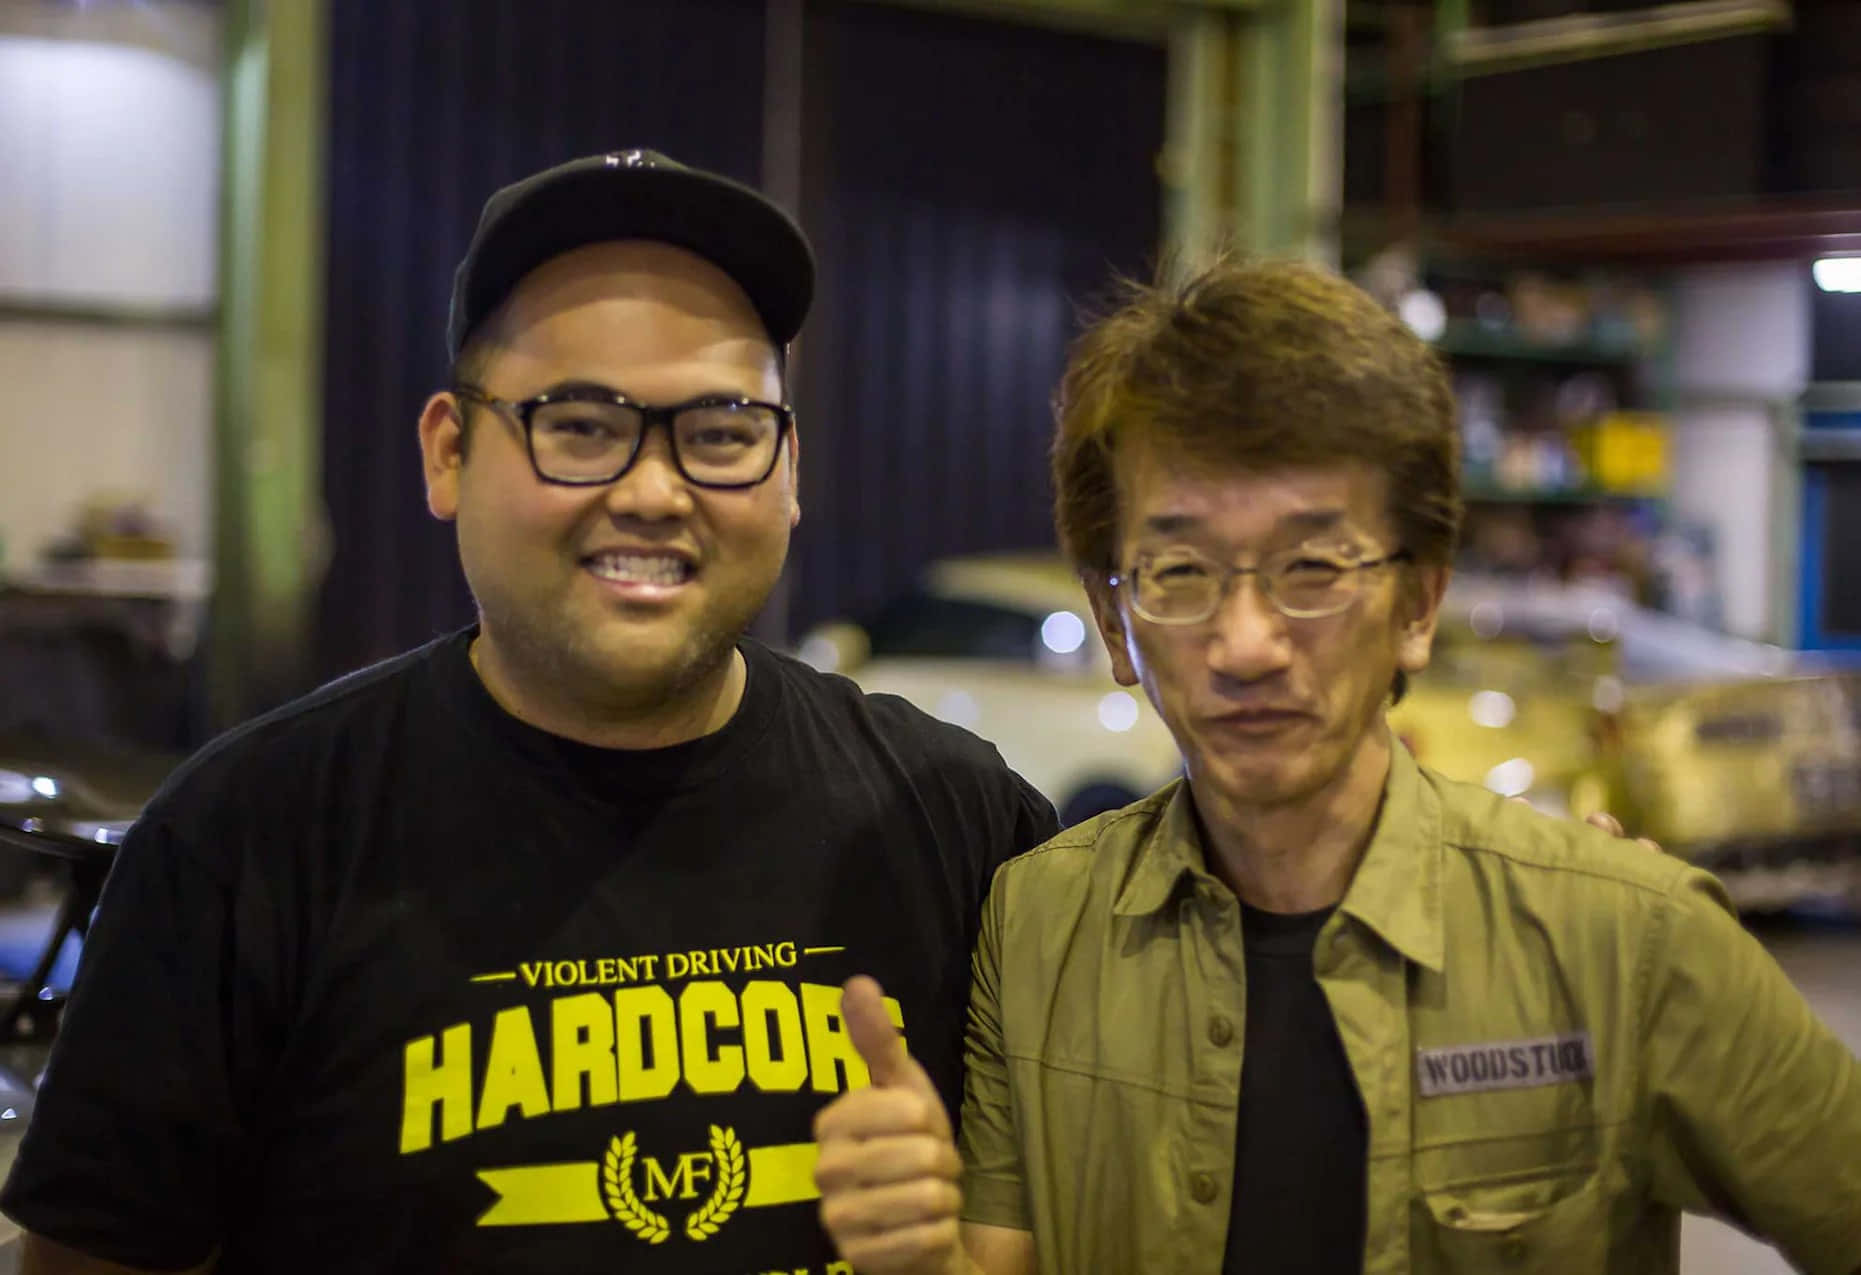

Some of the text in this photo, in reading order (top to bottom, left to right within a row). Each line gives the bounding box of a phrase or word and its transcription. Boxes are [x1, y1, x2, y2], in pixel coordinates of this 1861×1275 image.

[519, 941, 798, 987] VIOLENT DRIVING
[400, 980, 908, 1154] HARDCOR
[641, 1152, 714, 1201] MF
